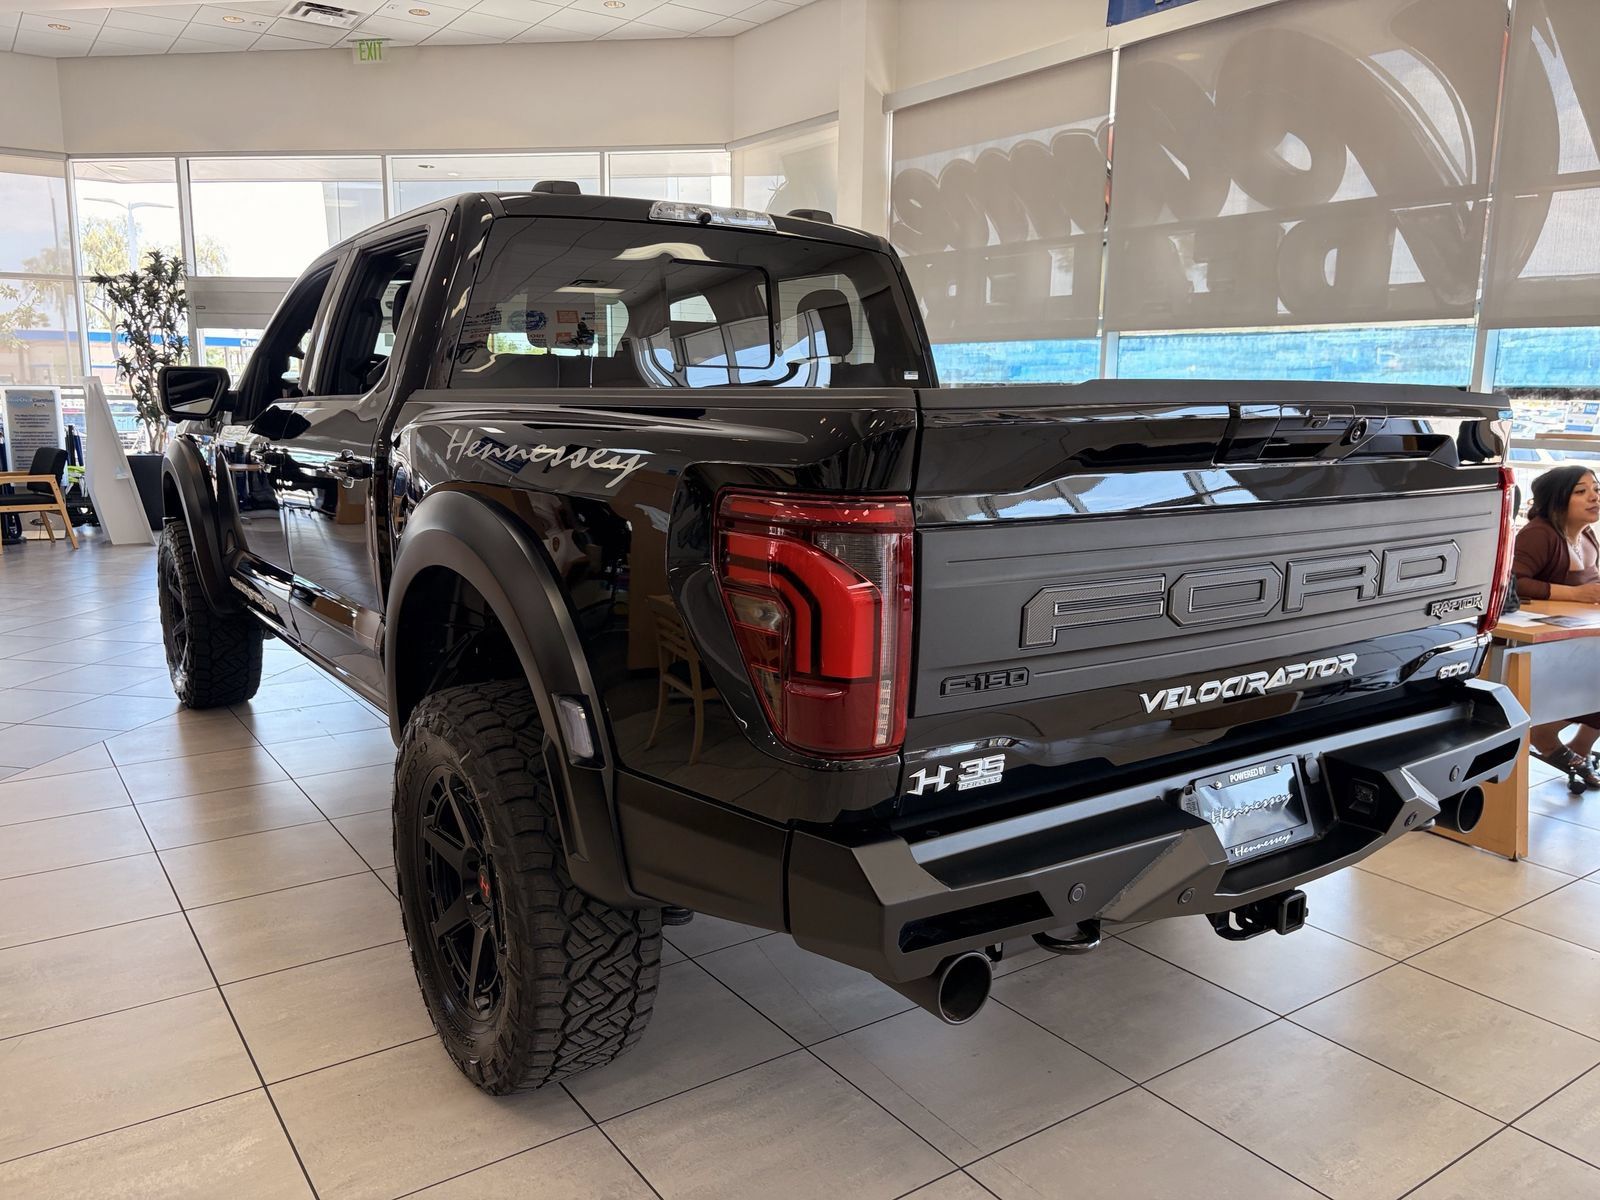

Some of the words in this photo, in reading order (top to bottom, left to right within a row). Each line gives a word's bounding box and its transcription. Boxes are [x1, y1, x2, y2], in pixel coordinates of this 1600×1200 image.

[358, 41, 383, 61] EXIT
[446, 429, 648, 489] Hennessey
[1019, 539, 1461, 649] FORD
[1427, 592, 1484, 619] RAPTOR
[940, 666, 1030, 698] F-150
[1139, 652, 1358, 714] VELOCIRAPTOR
[1438, 661, 1470, 680] 600
[958, 753, 1006, 780] 35
[1229, 768, 1258, 783] POWERED
[1258, 765, 1267, 777] BY
[1210, 792, 1293, 826] Hennessey
[1234, 833, 1292, 858] Hennessey
